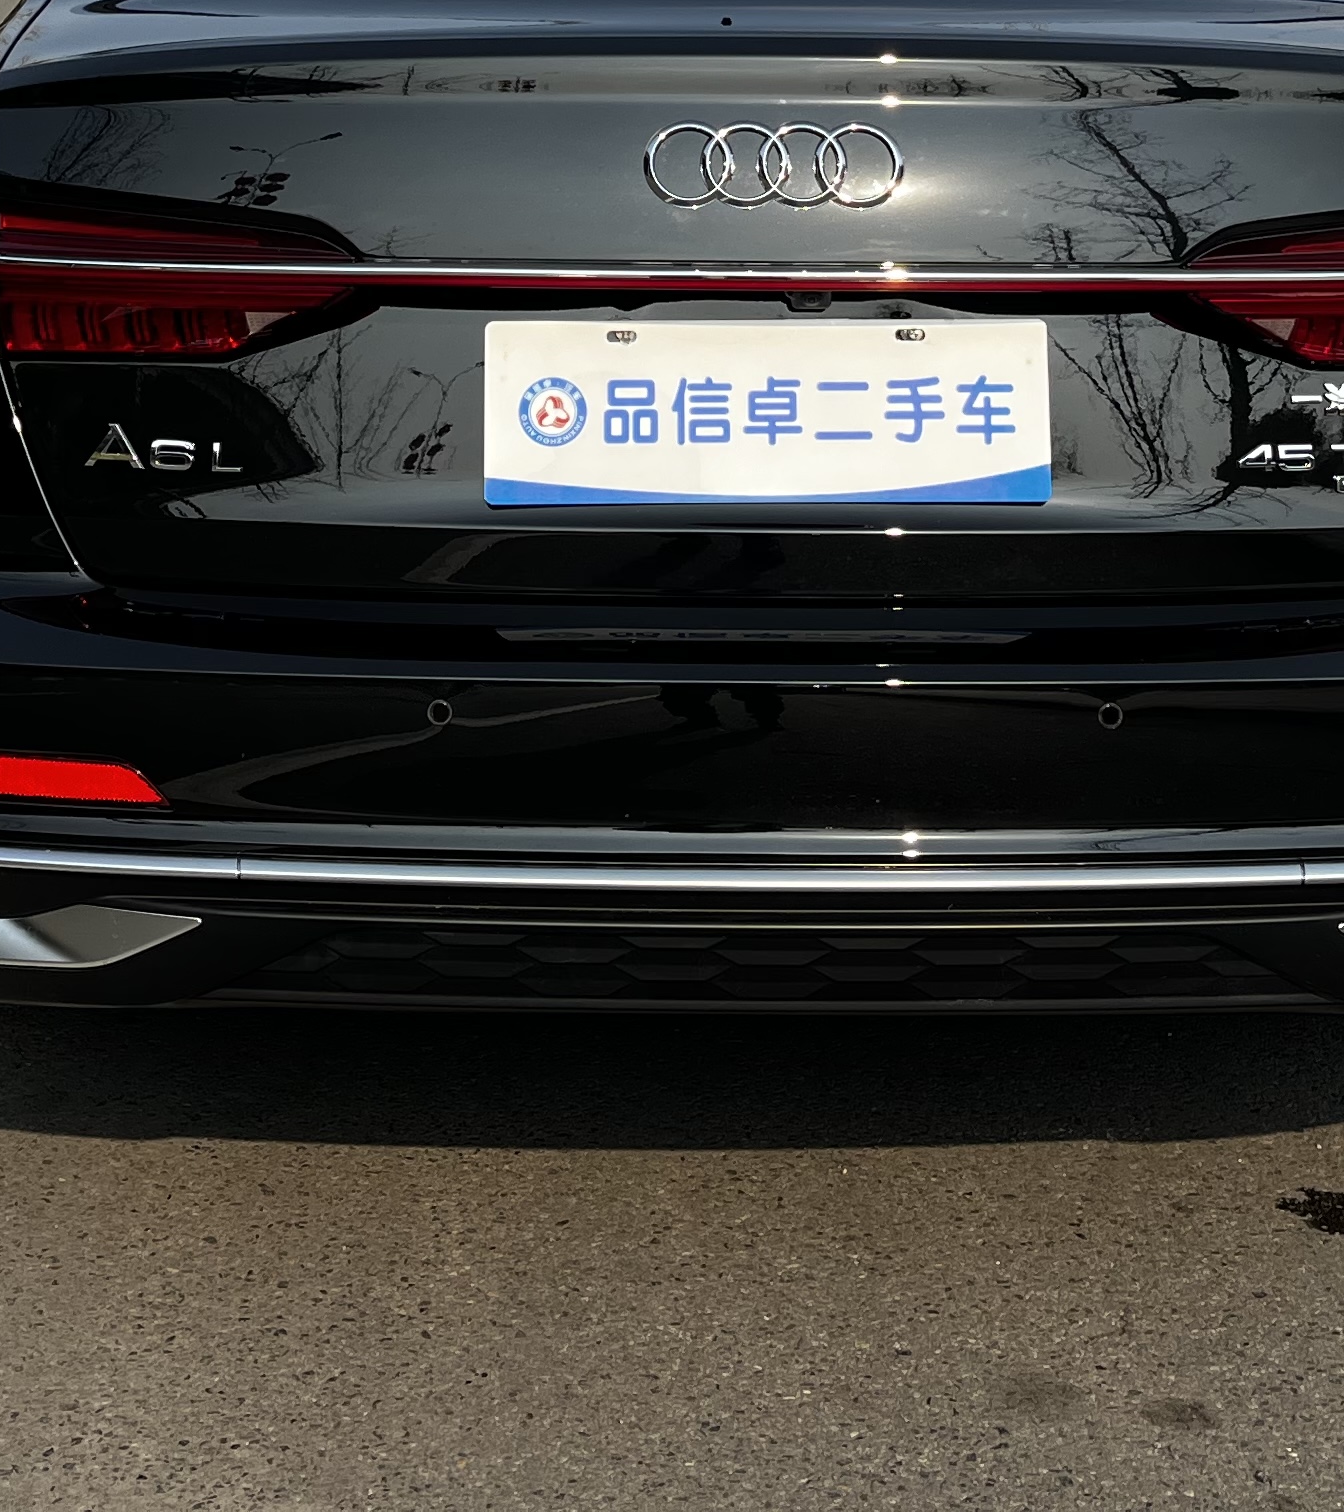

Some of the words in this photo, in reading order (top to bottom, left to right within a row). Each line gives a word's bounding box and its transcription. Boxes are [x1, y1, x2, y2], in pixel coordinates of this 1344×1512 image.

[602, 375, 1018, 446] 品信卓二手车
[1237, 443, 1316, 472] 45
